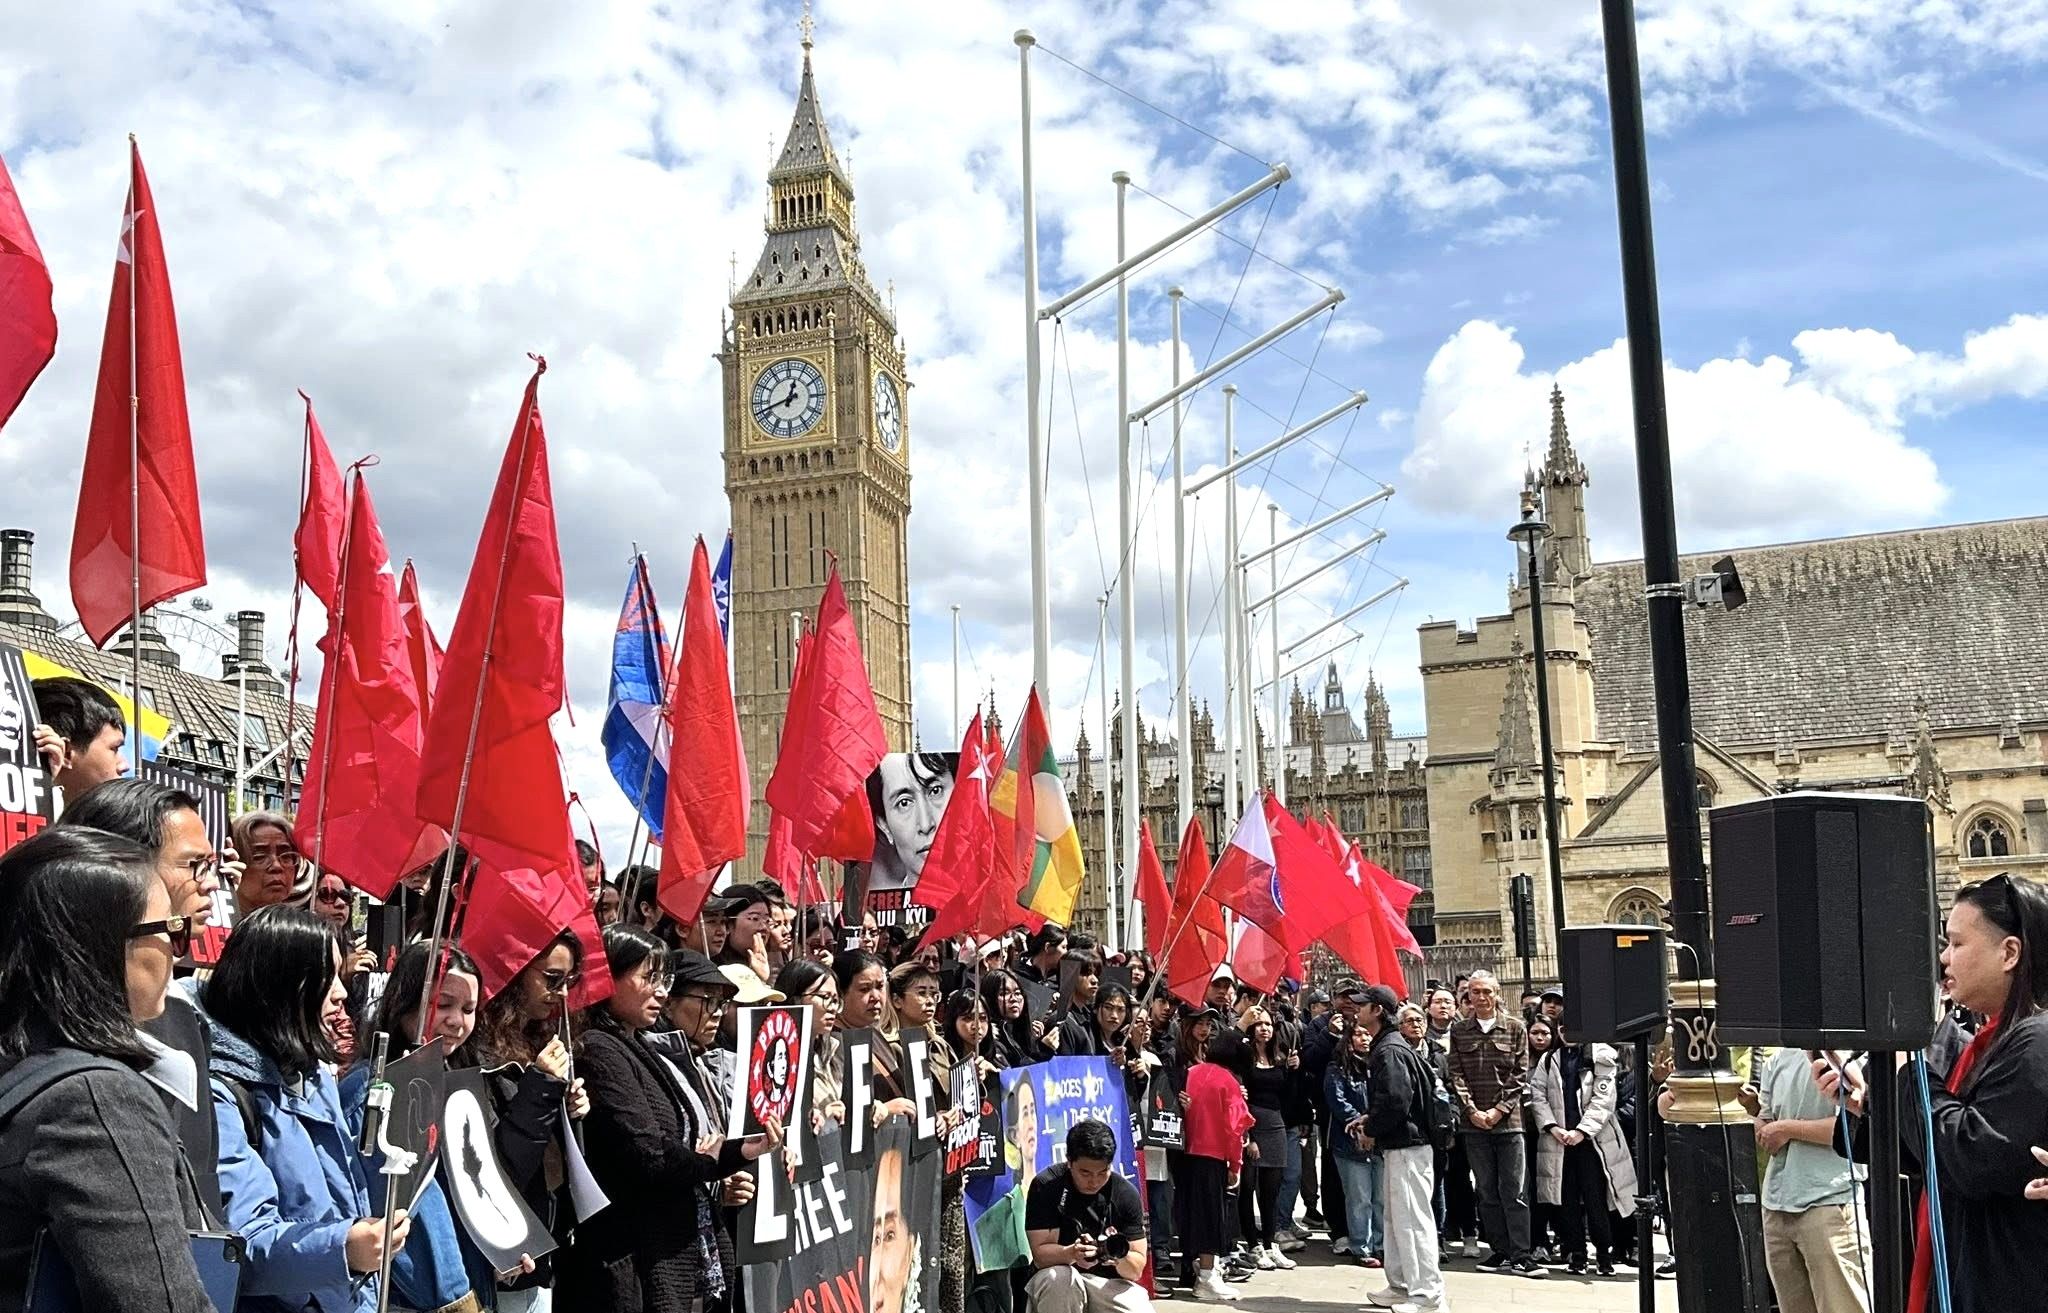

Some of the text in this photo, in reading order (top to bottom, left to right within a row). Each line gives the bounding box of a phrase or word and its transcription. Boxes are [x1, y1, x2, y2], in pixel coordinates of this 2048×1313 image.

[869, 891, 902, 909] FREE
[877, 908, 926, 927] UU KYI
[1726, 914, 1763, 925] BOSE
[758, 1014, 797, 1051] PROOF
[948, 1114, 980, 1152] PROOF
[946, 1148, 960, 1175] OF
[960, 1140, 978, 1168] LIFE
[794, 1162, 853, 1254] REE
